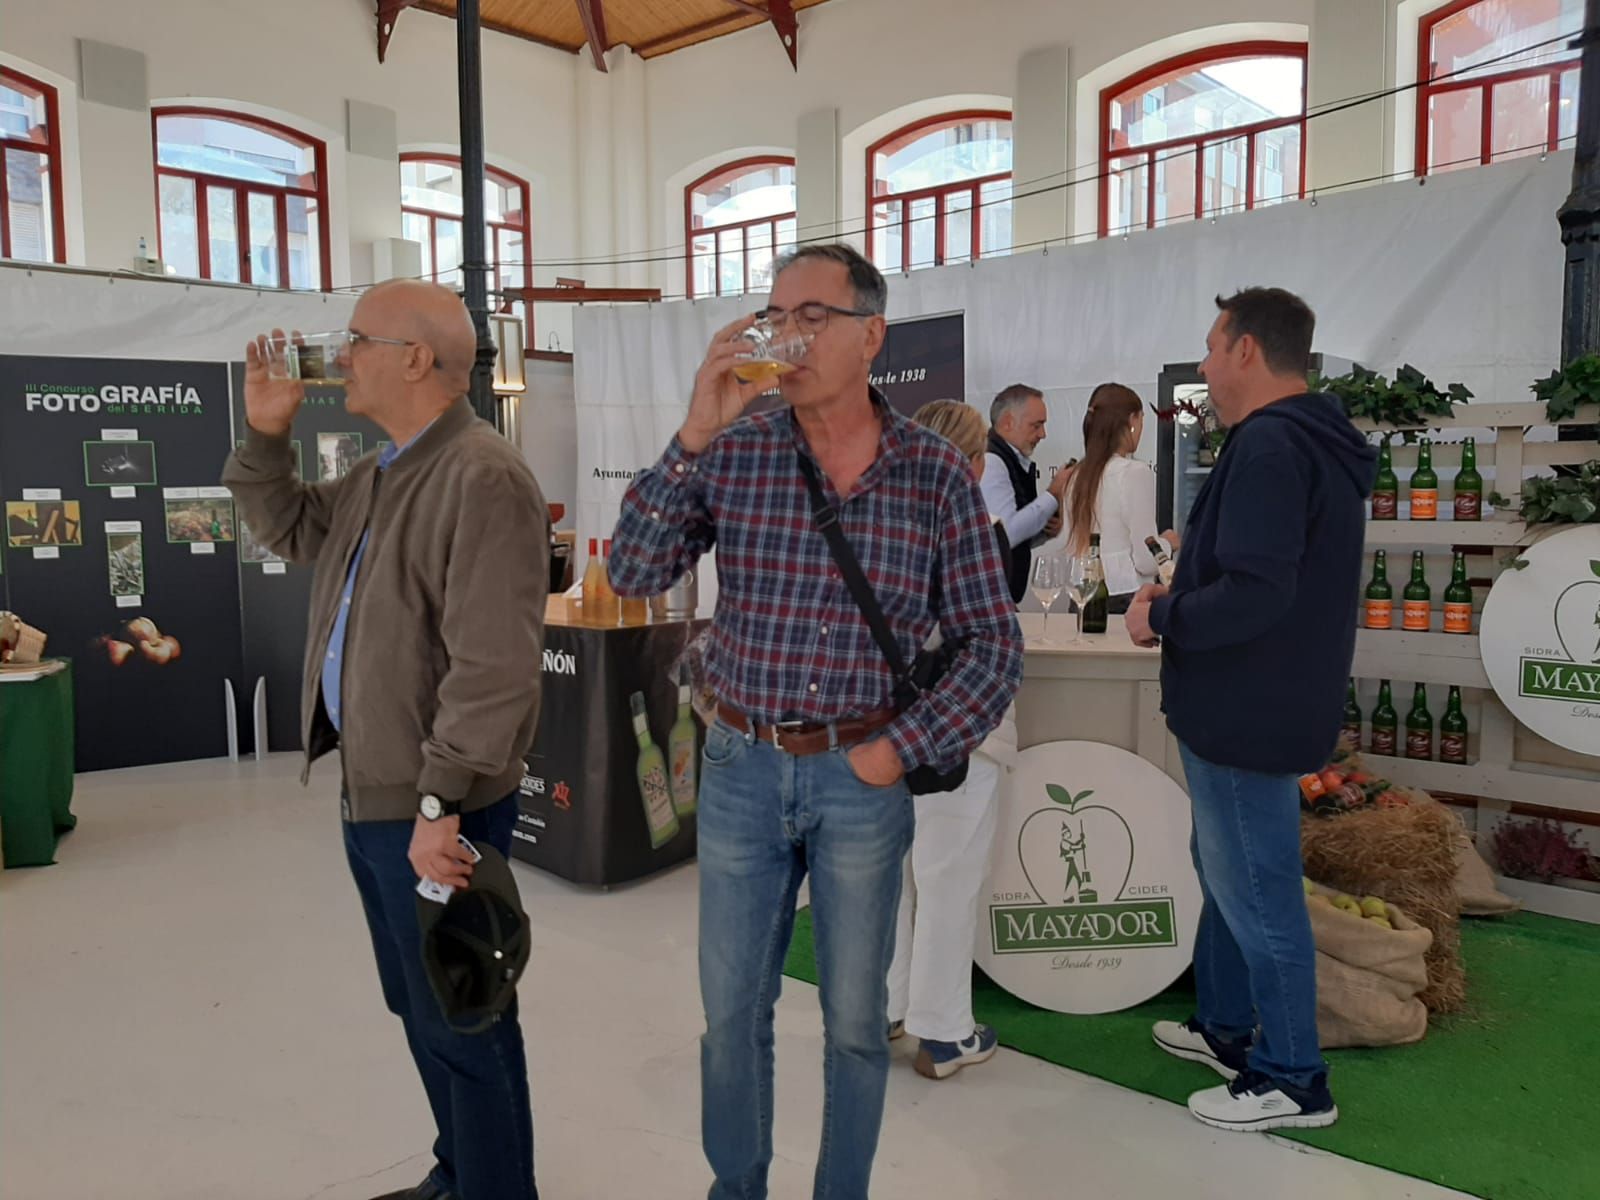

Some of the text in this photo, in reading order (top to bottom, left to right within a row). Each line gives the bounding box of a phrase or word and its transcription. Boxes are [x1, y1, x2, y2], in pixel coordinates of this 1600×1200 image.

[900, 367, 926, 383] 1938
[25, 384, 95, 394] III Concurso
[25, 383, 202, 412] FOTO GRAFÍA
[107, 405, 202, 414] del SERIDA
[1524, 646, 1560, 656] SIDRA
[541, 649, 576, 675] ÑÓN
[1128, 885, 1168, 895] CIDER
[993, 892, 1031, 902] SIDRA
[1003, 911, 1163, 942] MAYADOR
[1051, 954, 1122, 970] Desde 1939
